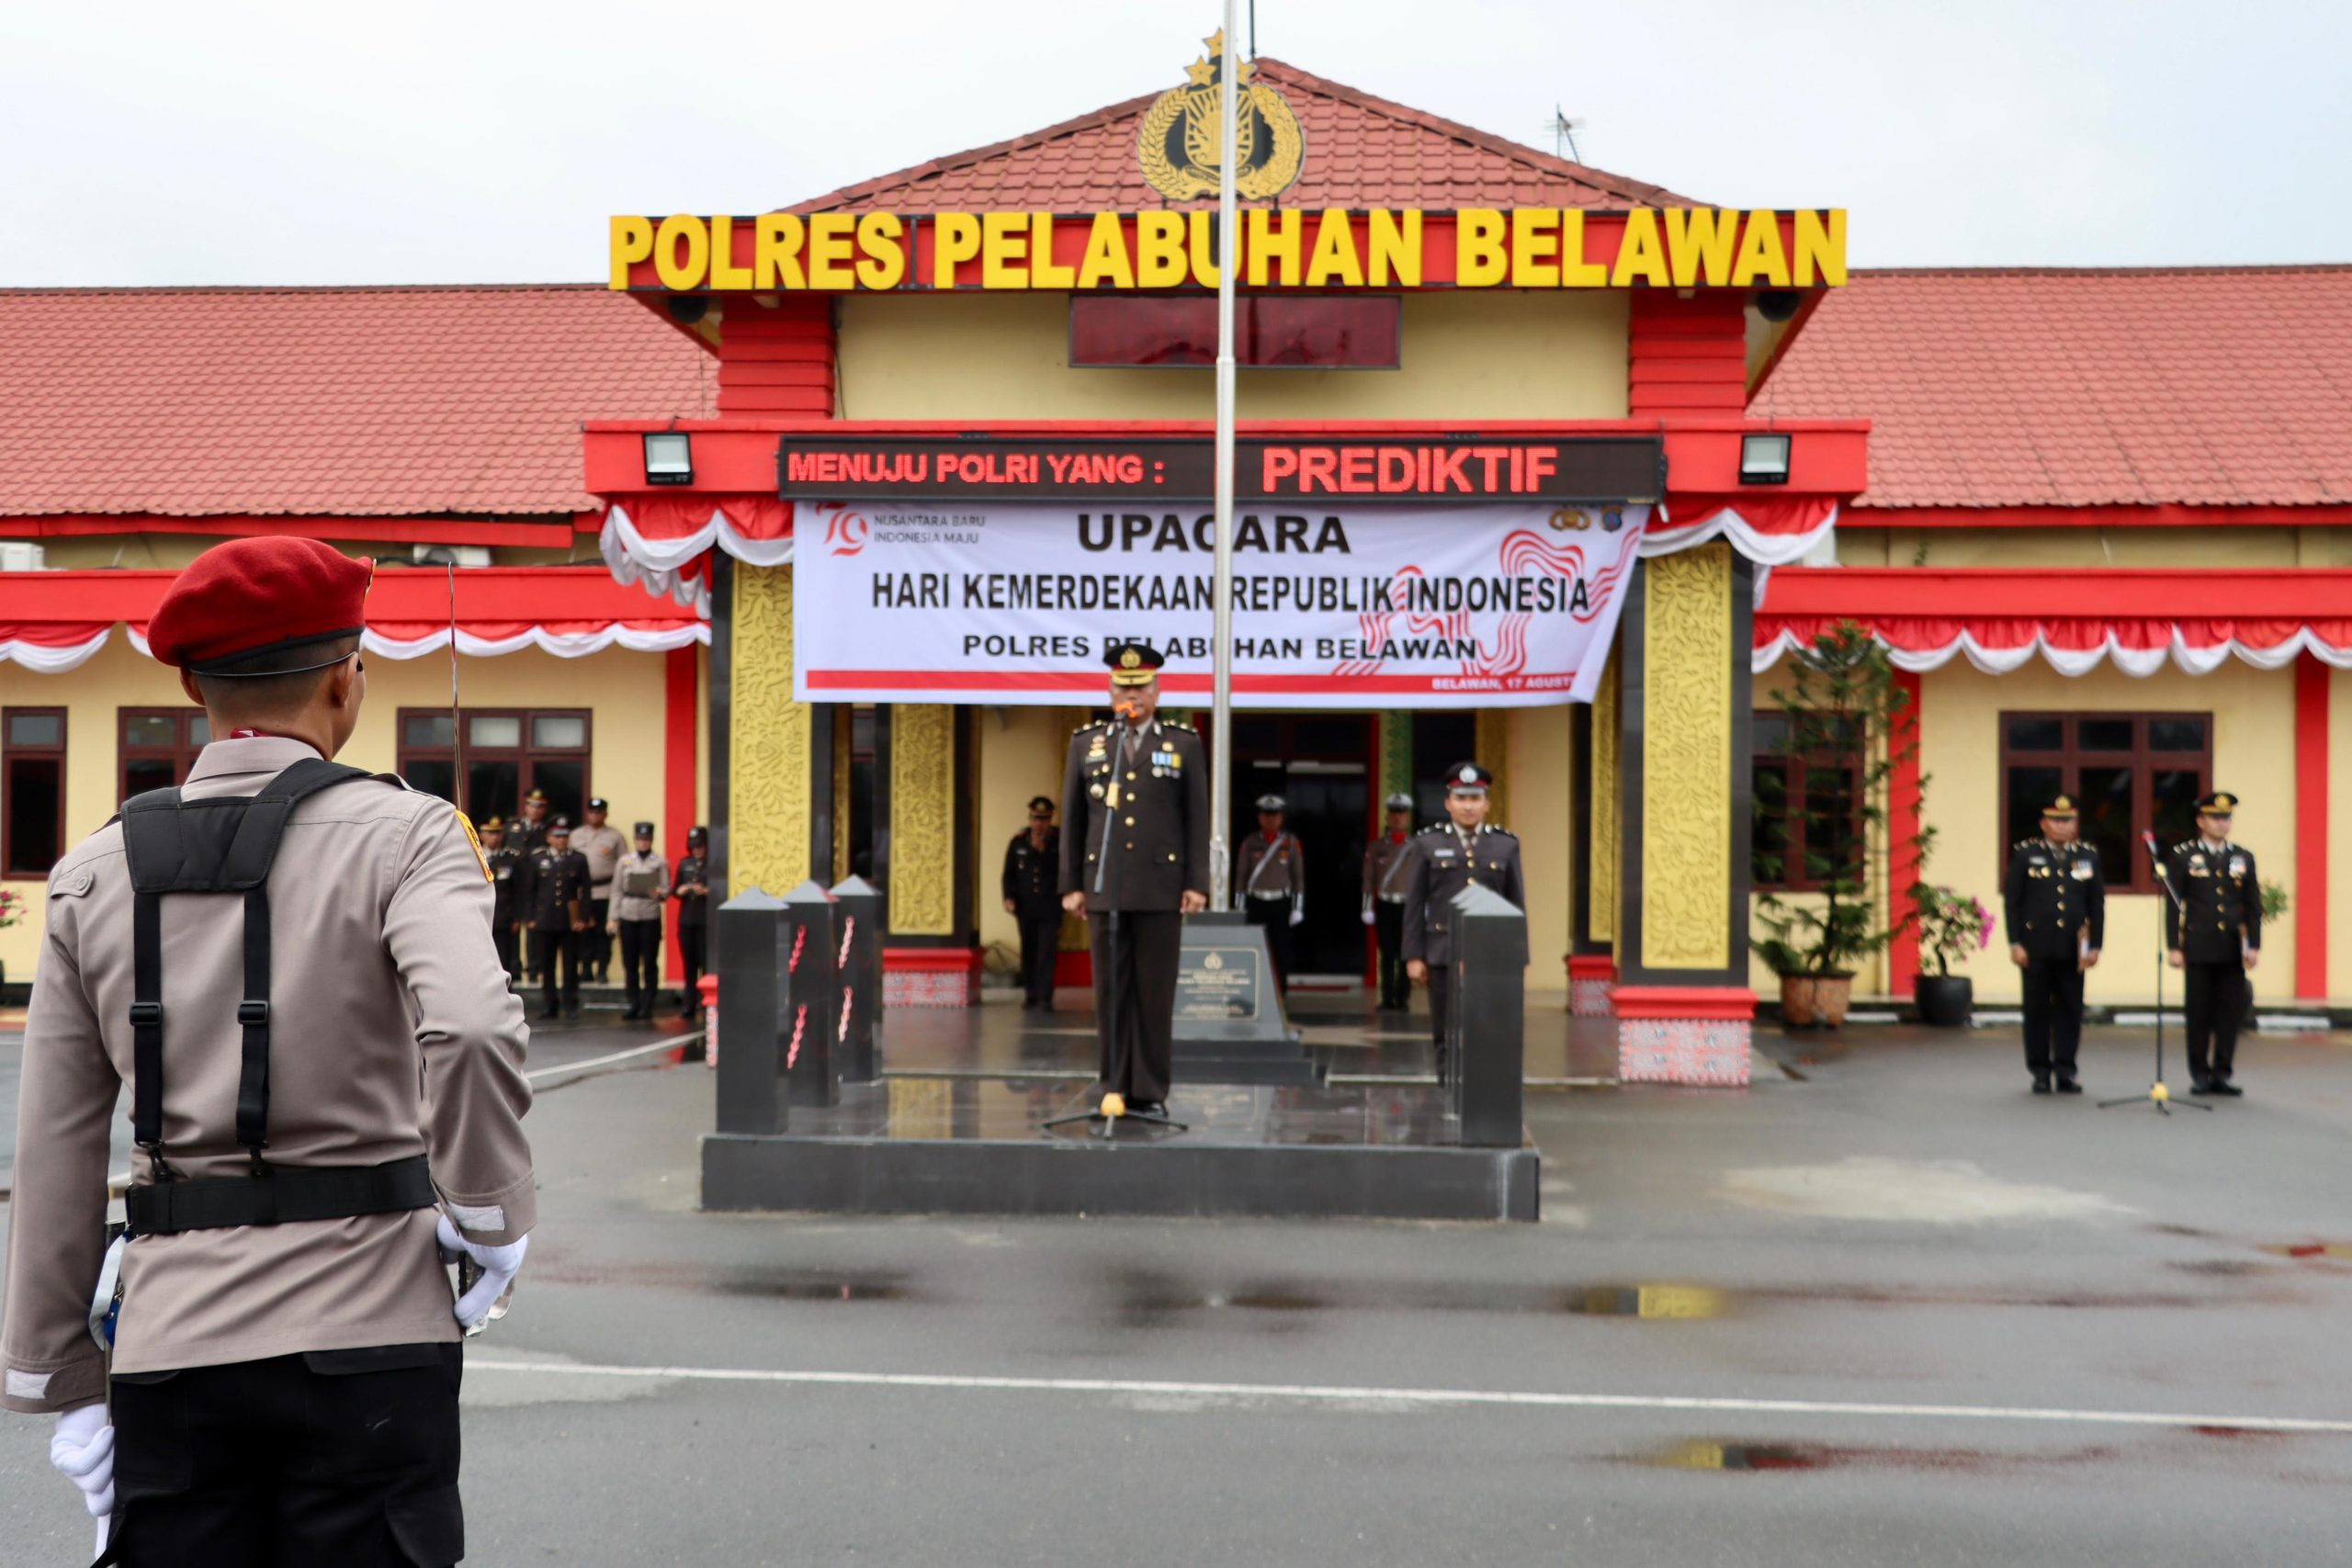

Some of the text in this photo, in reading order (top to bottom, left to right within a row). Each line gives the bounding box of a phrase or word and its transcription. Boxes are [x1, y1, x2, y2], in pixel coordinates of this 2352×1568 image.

[610, 208, 1847, 290] POLRES PELABUHAN BELAWAN
[787, 453, 927, 483] MENUJU
[936, 454, 1038, 483] POLRI
[1046, 455, 1144, 484] YANG
[1262, 446, 1559, 493] PREDIKTIF
[874, 514, 986, 527] NUSANTARA BARU
[874, 531, 979, 545] INDONESIA MAJU
[873, 572, 1590, 613] HARI KEMERDEKAAN REPUBLIK INDONESIA
[964, 635, 1091, 659] POLRES
[1316, 637, 1477, 660] BELAWAN
[1431, 677, 1502, 691] BELAWAN,
[1507, 678, 1522, 689] 17
